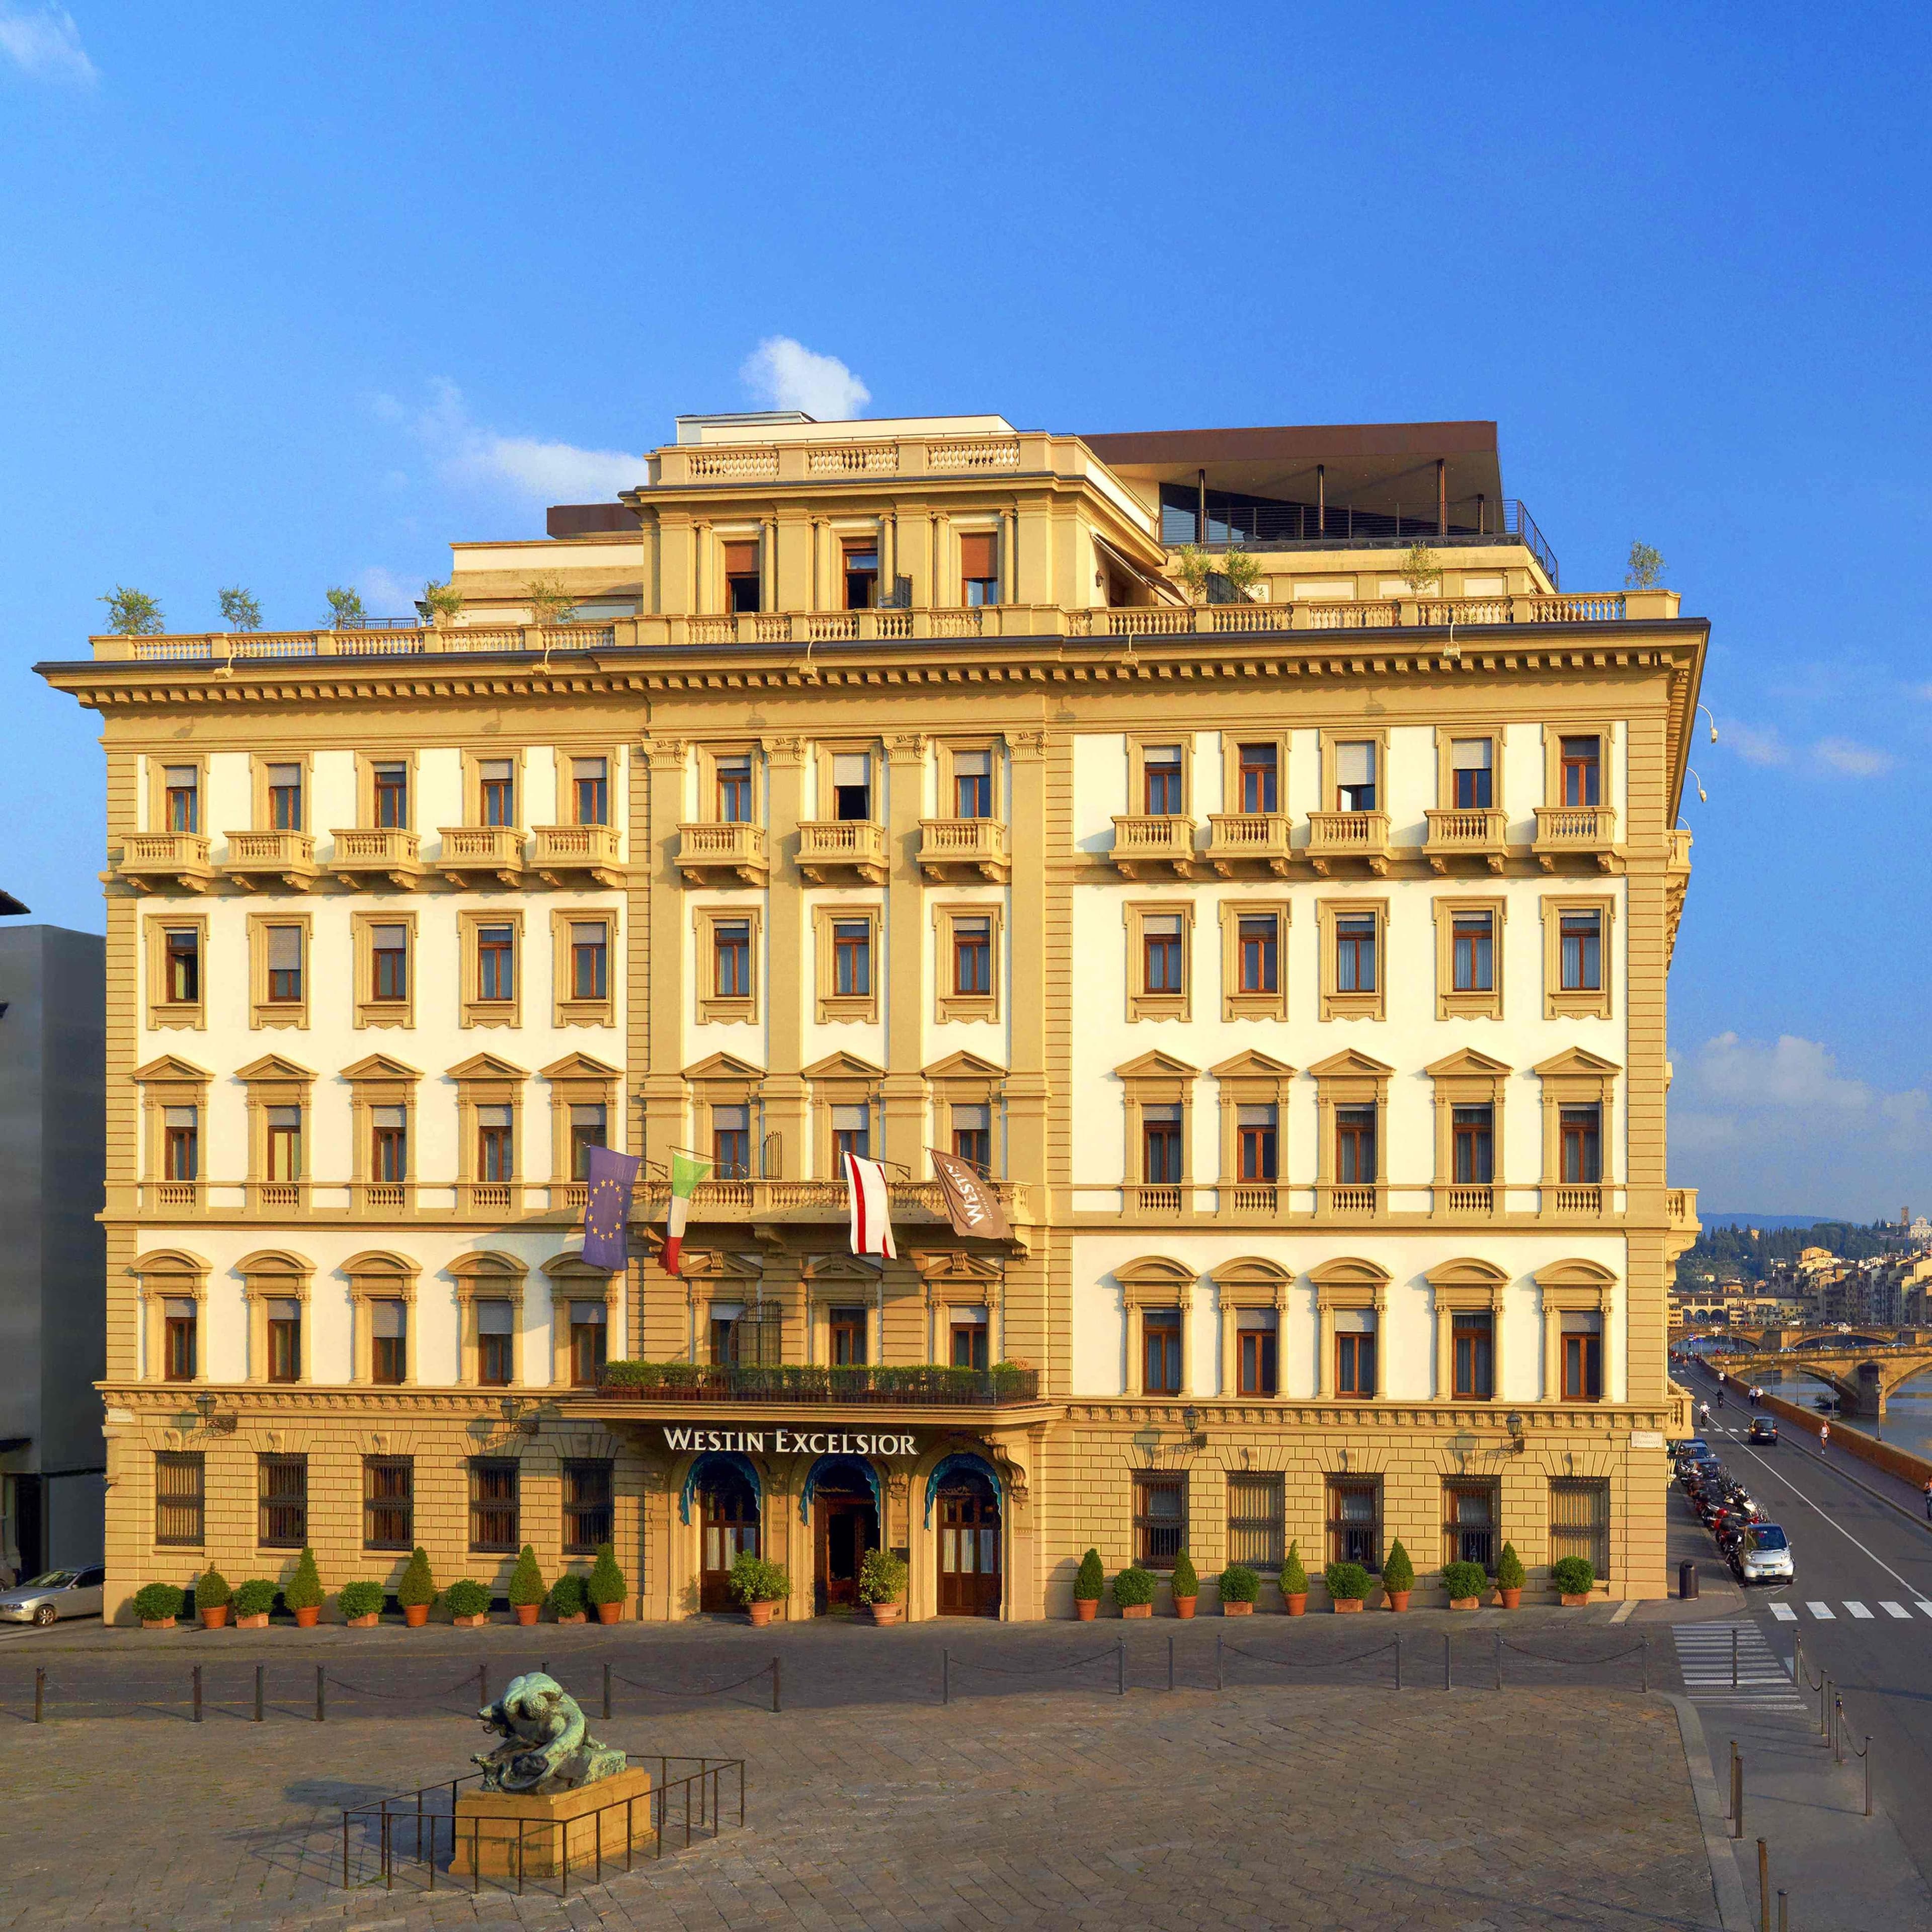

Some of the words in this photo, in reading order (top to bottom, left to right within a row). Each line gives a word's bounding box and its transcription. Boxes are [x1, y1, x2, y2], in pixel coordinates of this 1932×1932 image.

[944, 1163, 985, 1226] WESTIN
[663, 1427, 765, 1453] WESTIN
[775, 1428, 920, 1455] EXCELSIOR
